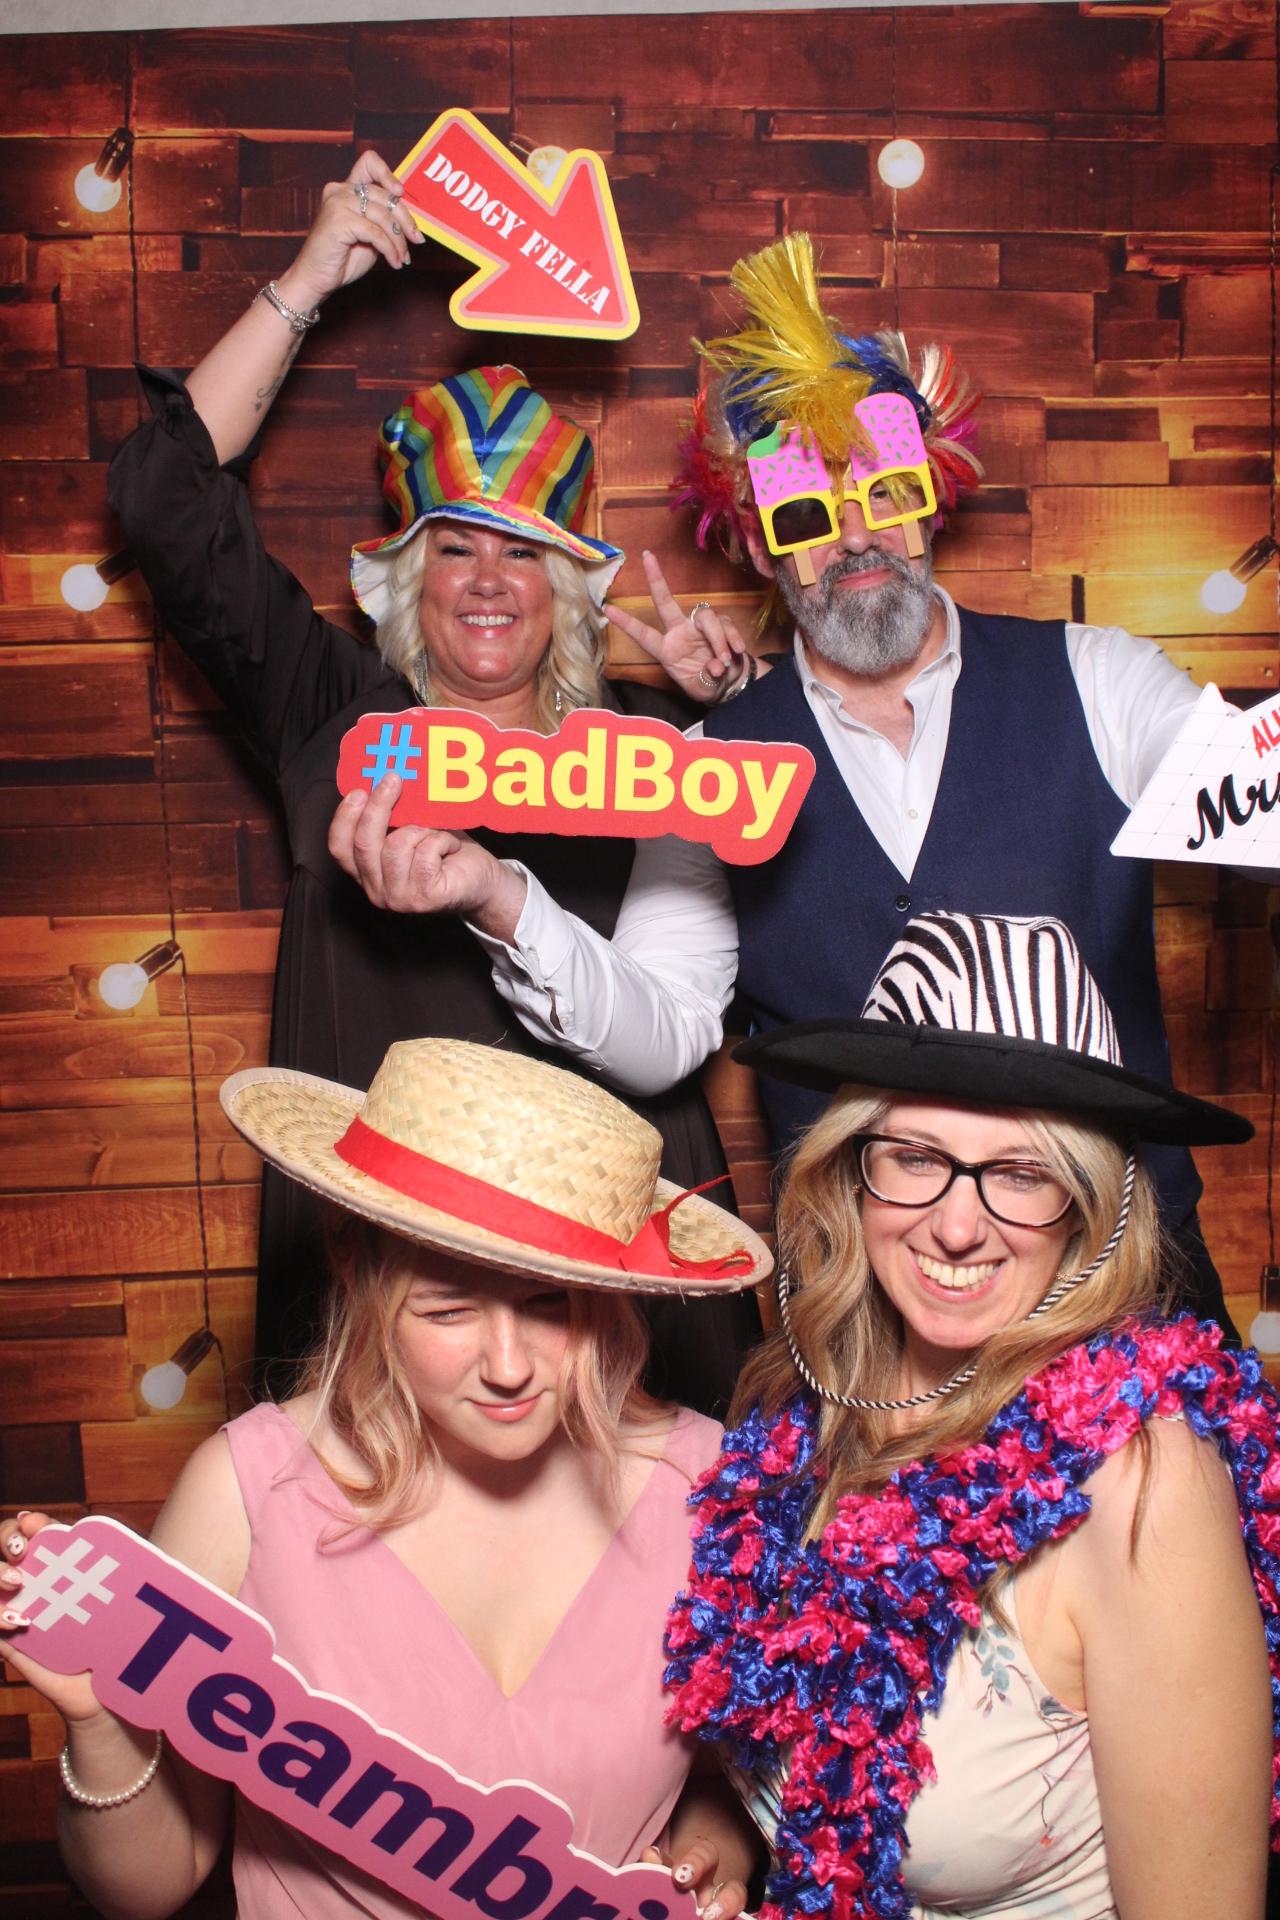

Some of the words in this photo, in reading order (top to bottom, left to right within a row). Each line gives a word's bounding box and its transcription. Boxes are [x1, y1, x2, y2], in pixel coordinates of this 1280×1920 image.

[424, 153, 526, 240] DODGY
[519, 231, 610, 315] FELLA
[362, 723, 798, 840] #BadBoy
[1187, 772, 1280, 850] Mr
